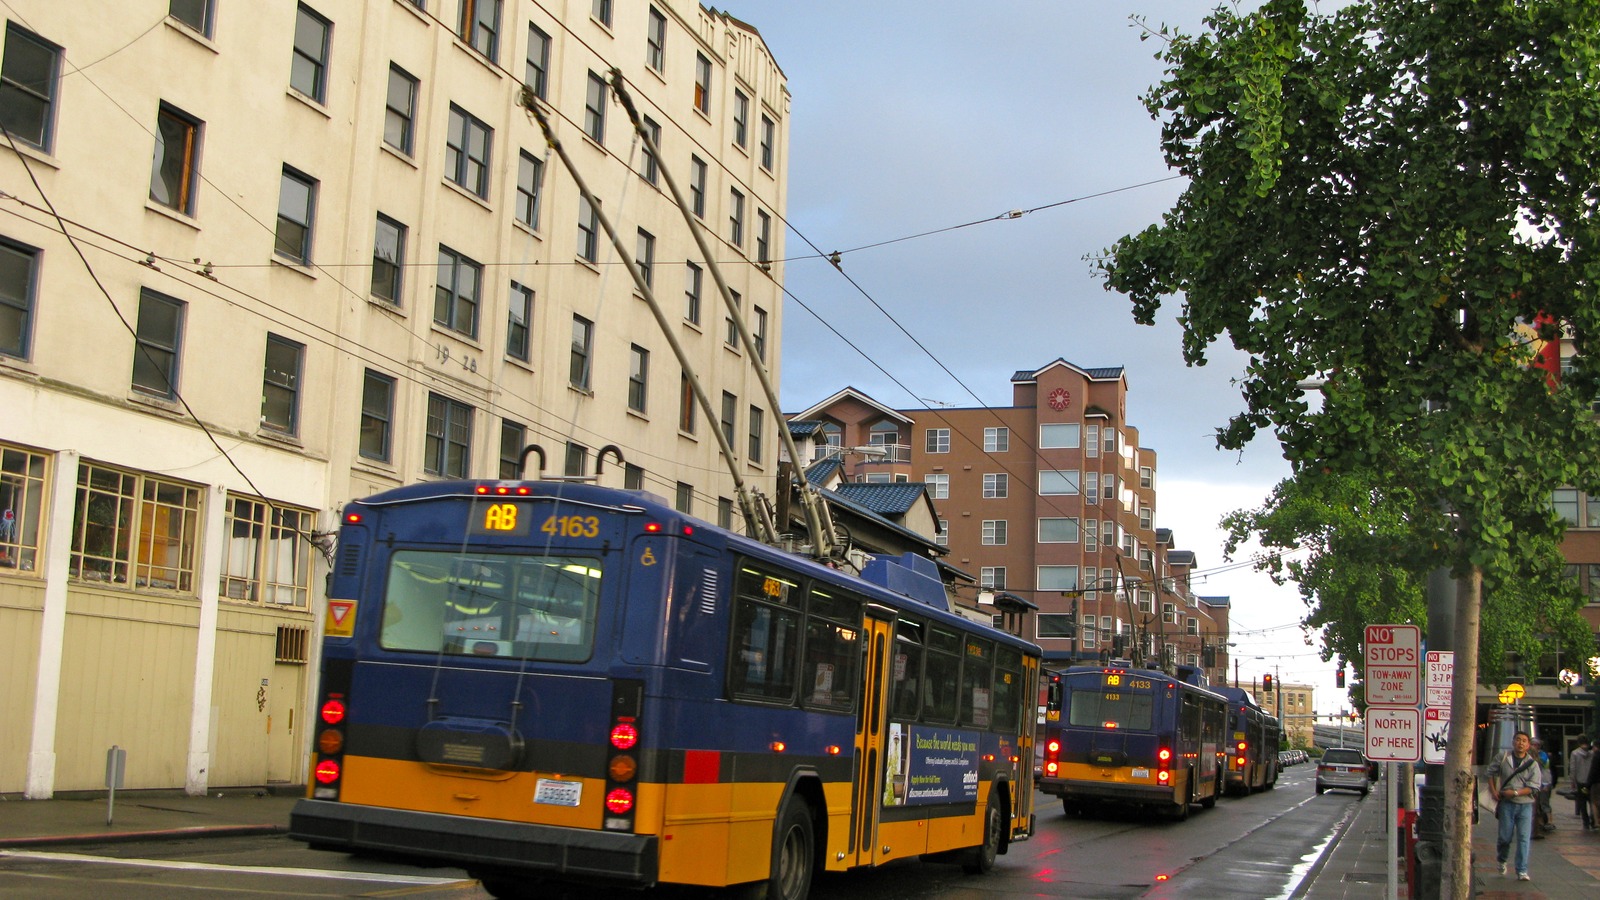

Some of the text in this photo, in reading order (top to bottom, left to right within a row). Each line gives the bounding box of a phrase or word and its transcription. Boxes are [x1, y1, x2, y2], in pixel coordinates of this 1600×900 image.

[436, 343, 449, 365] 19
[484, 503, 518, 531] AB
[541, 516, 599, 538] 4163
[1370, 628, 1390, 642] NO
[1370, 647, 1414, 661] STOPS
[1428, 653, 1438, 661] NO
[1431, 663, 1454, 672] STOP
[1107, 675, 1120, 686] AB
[1372, 670, 1412, 680] TOW-AWAY
[1432, 673, 1444, 682] 3-7
[1129, 680, 1151, 689] 4133
[1380, 681, 1404, 691] ZONE
[1105, 693, 1120, 701] 4133
[1374, 718, 1411, 730] NORTH
[1371, 737, 1384, 747] OF
[1387, 738, 1414, 748] HERE
